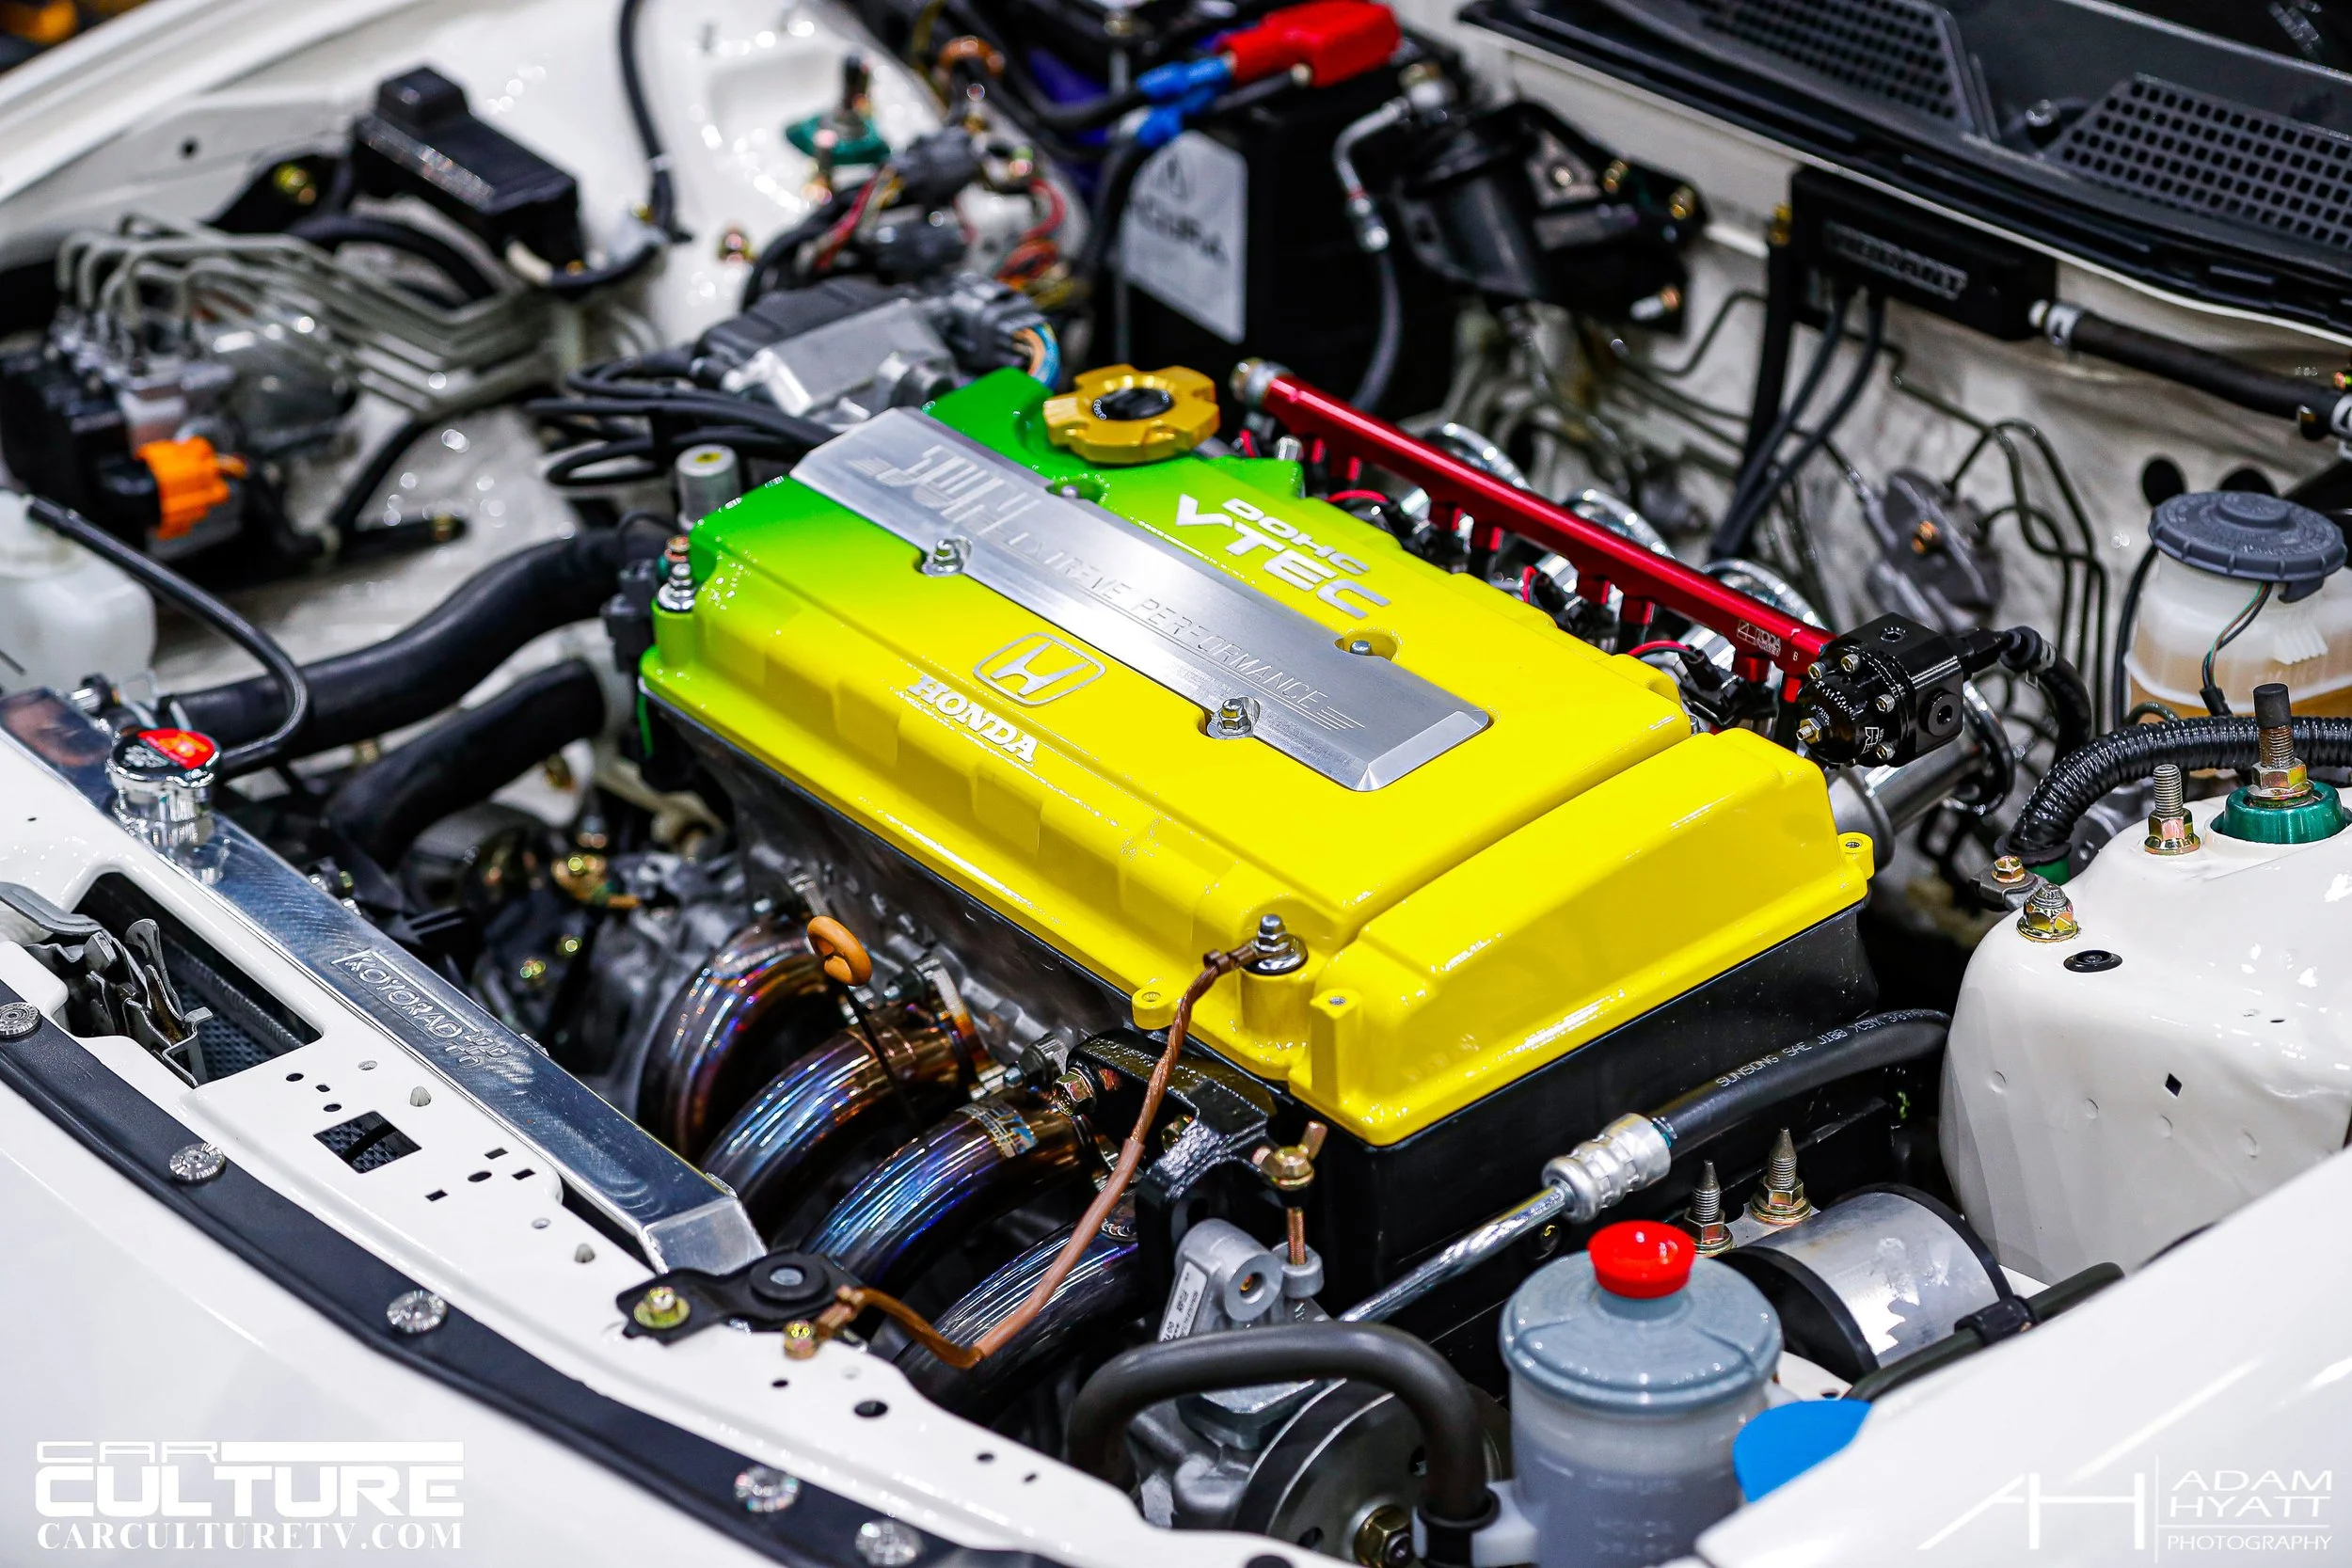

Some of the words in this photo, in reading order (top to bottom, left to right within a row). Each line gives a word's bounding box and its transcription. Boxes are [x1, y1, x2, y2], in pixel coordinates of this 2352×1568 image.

[1175, 493, 1391, 620] VTEC
[1222, 498, 1371, 576] DOHC
[1130, 597, 1328, 710] PERFORMANCE
[907, 674, 1039, 765] HONDA
[344, 956, 463, 1039] KOYORAD
[1715, 1053, 1780, 1088] SUNSONG
[1782, 1040, 1813, 1058] SAE
